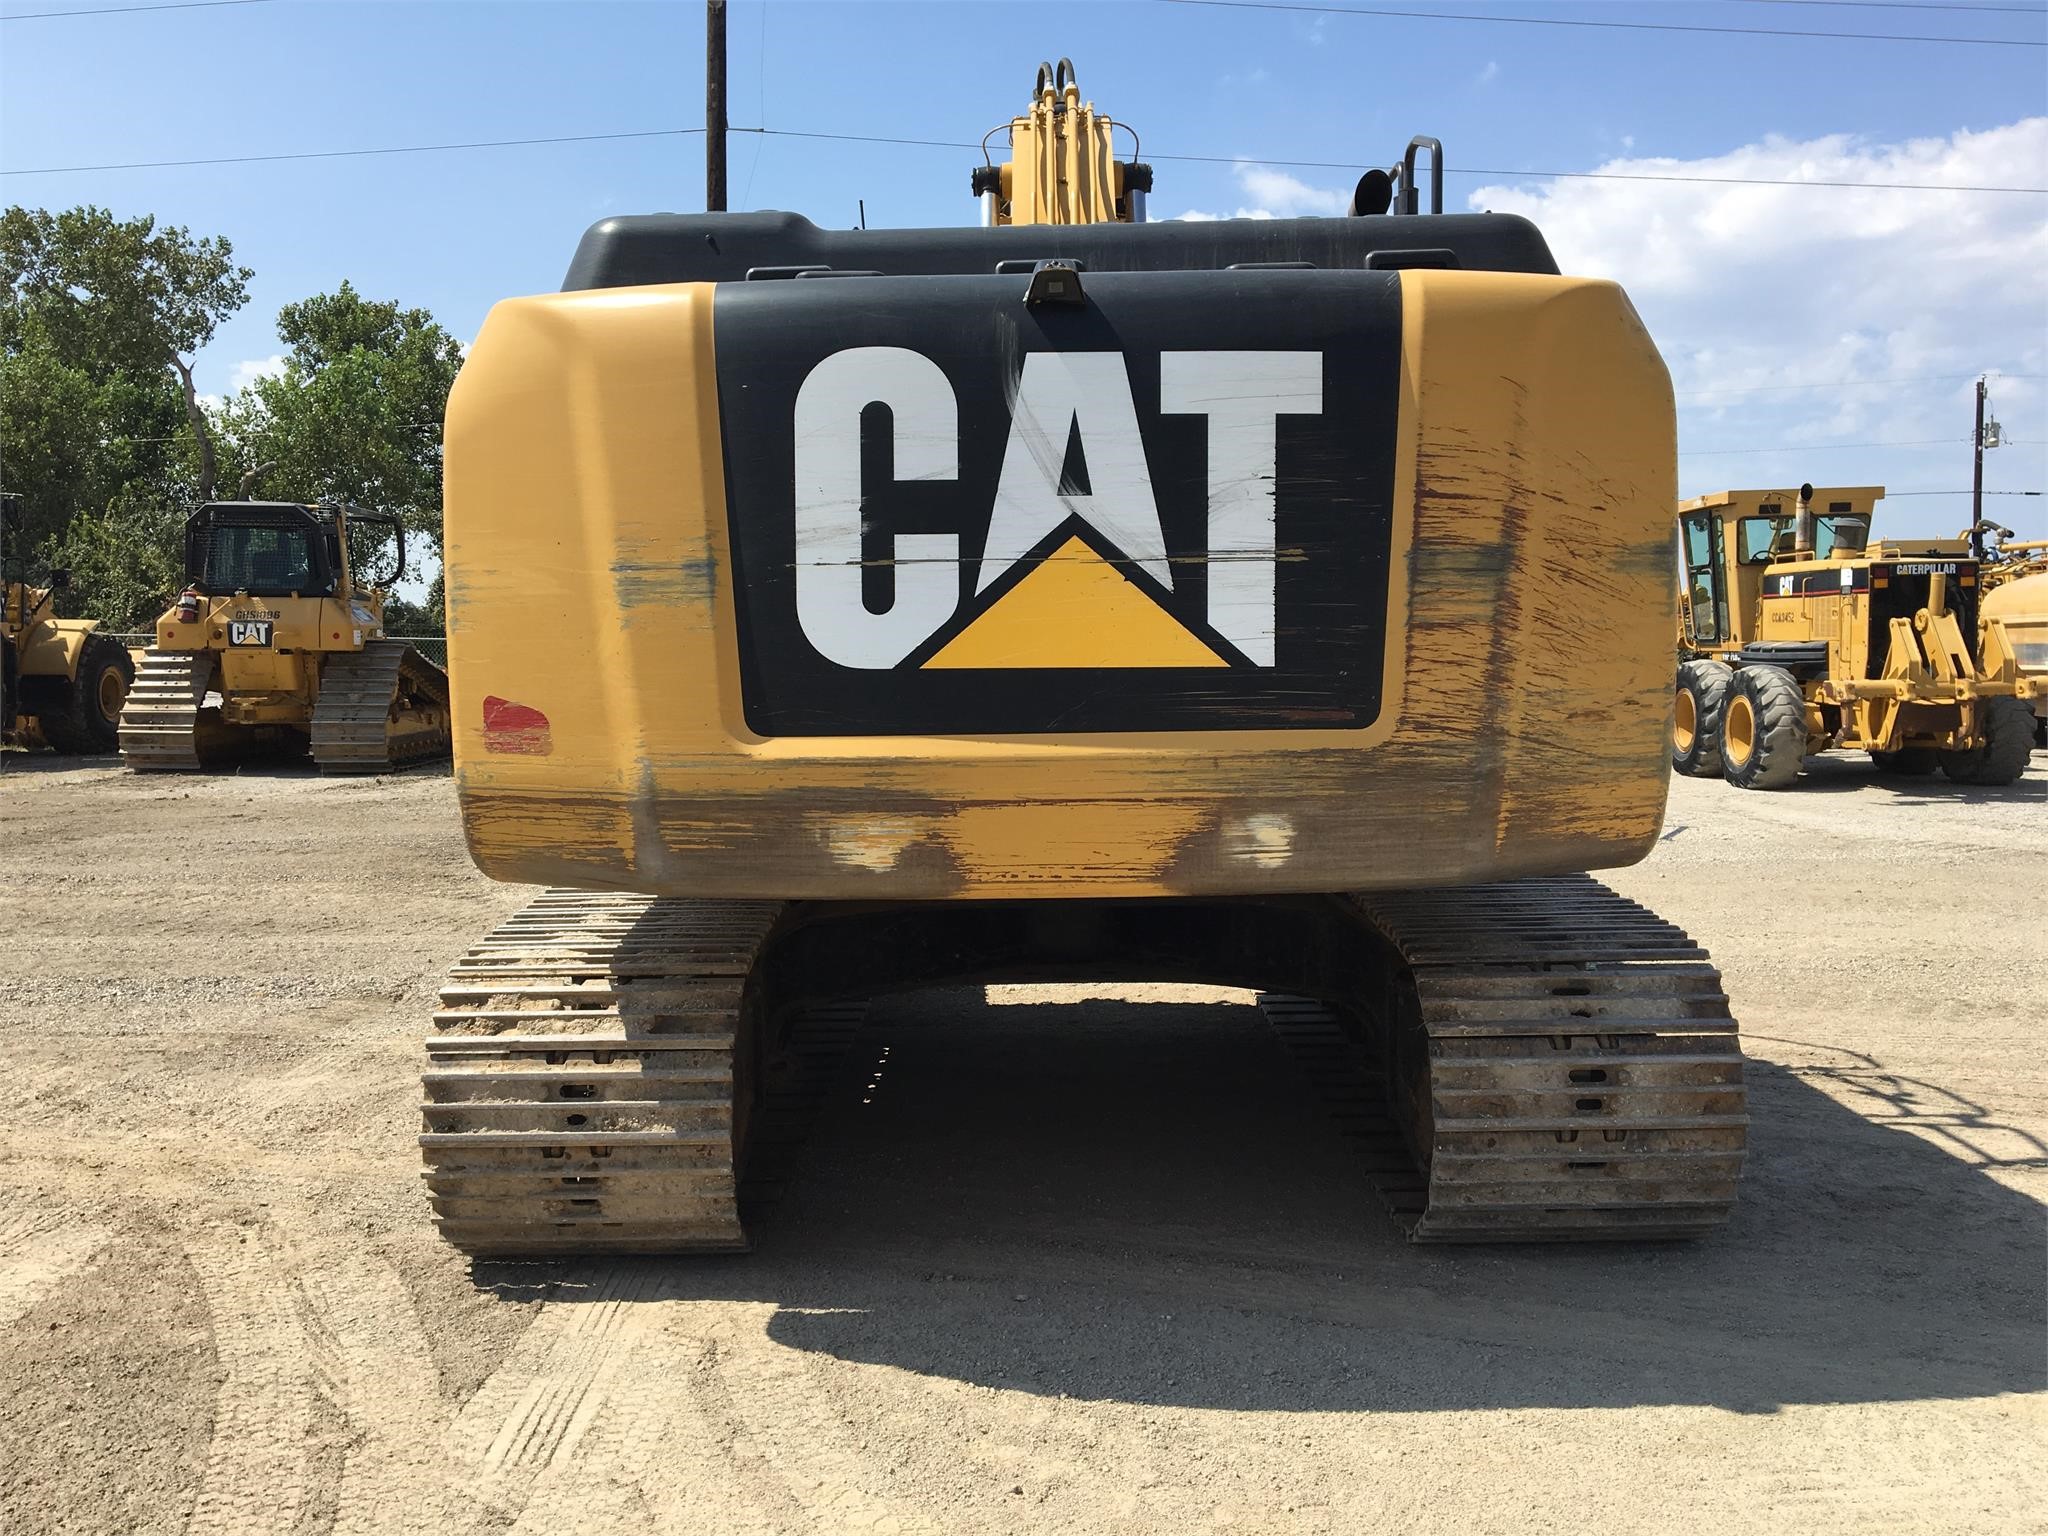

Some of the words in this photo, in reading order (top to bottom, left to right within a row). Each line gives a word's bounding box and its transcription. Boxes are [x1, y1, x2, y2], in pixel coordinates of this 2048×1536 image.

[794, 346, 1323, 670] CAT
[1896, 563, 1956, 575] CATERPILLAR
[1779, 575, 1795, 597] CAT
[232, 622, 269, 645] CAT
